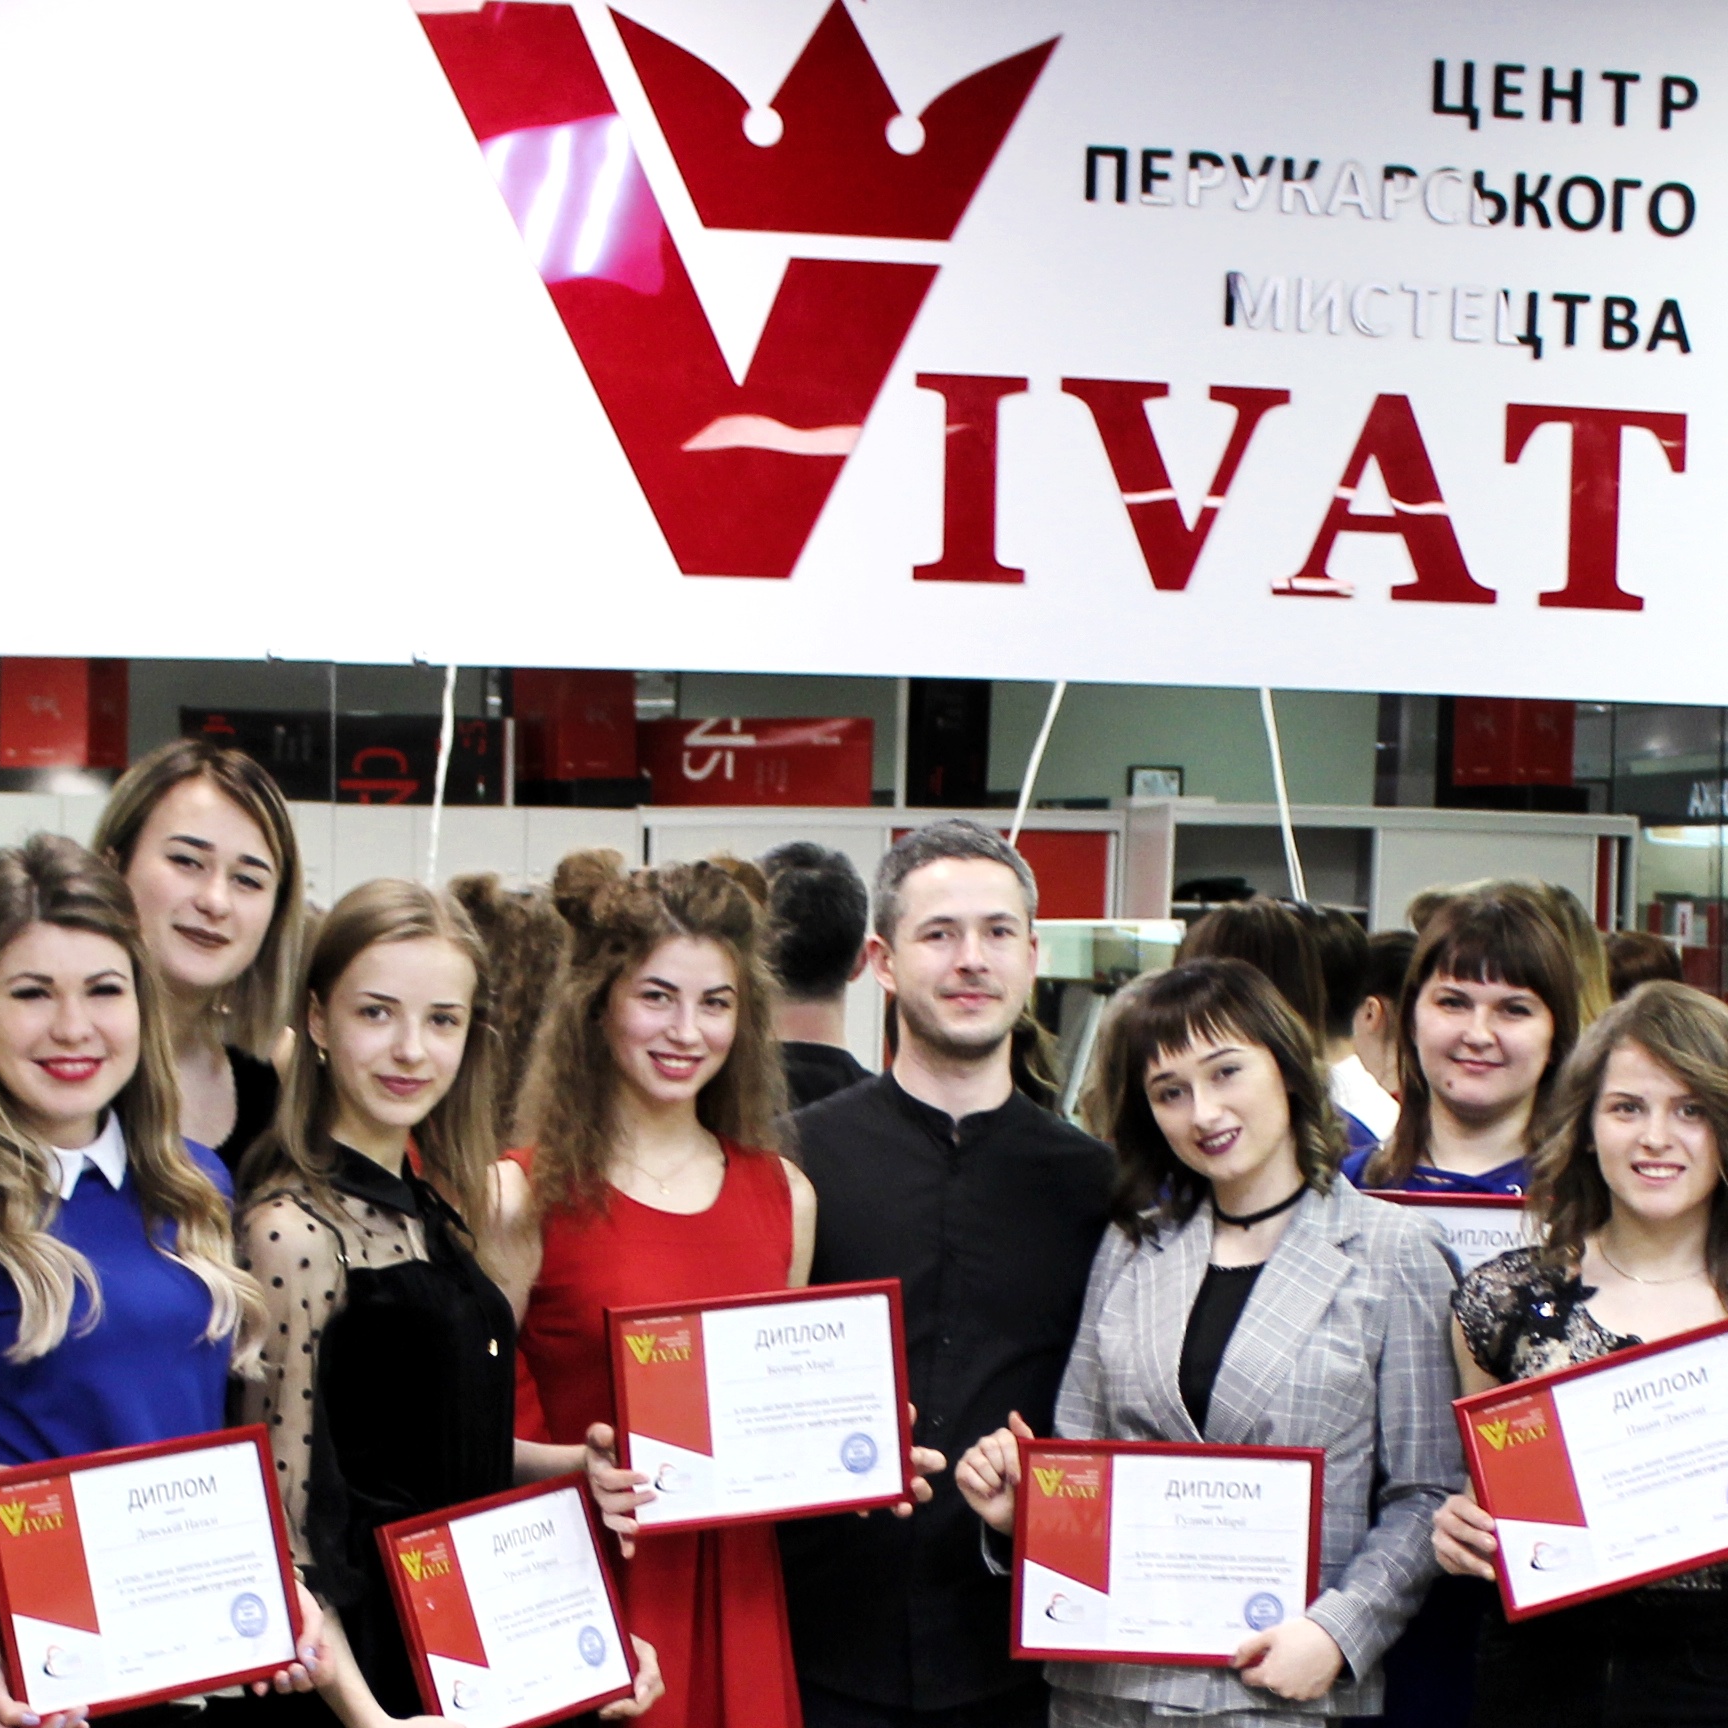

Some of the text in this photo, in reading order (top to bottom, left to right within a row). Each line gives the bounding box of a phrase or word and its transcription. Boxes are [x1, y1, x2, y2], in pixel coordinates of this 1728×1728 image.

[1432, 58, 1700, 130] ЦЕНТР
[1084, 143, 1697, 238] ПЕРУКАРСЬКОГО
[1224, 271, 1692, 359] МИСТЕЦТВА
[1448, 1228, 1521, 1248] ИПЛОМ
[754, 1321, 846, 1350] ДИПЛОМ
[1611, 1366, 1710, 1415] ДИПЛОМ
[126, 1474, 219, 1513] ДИПЛОМ
[1163, 1478, 1262, 1501] ДИПЛОМ
[490, 1518, 558, 1557] ДИПЛОМ
